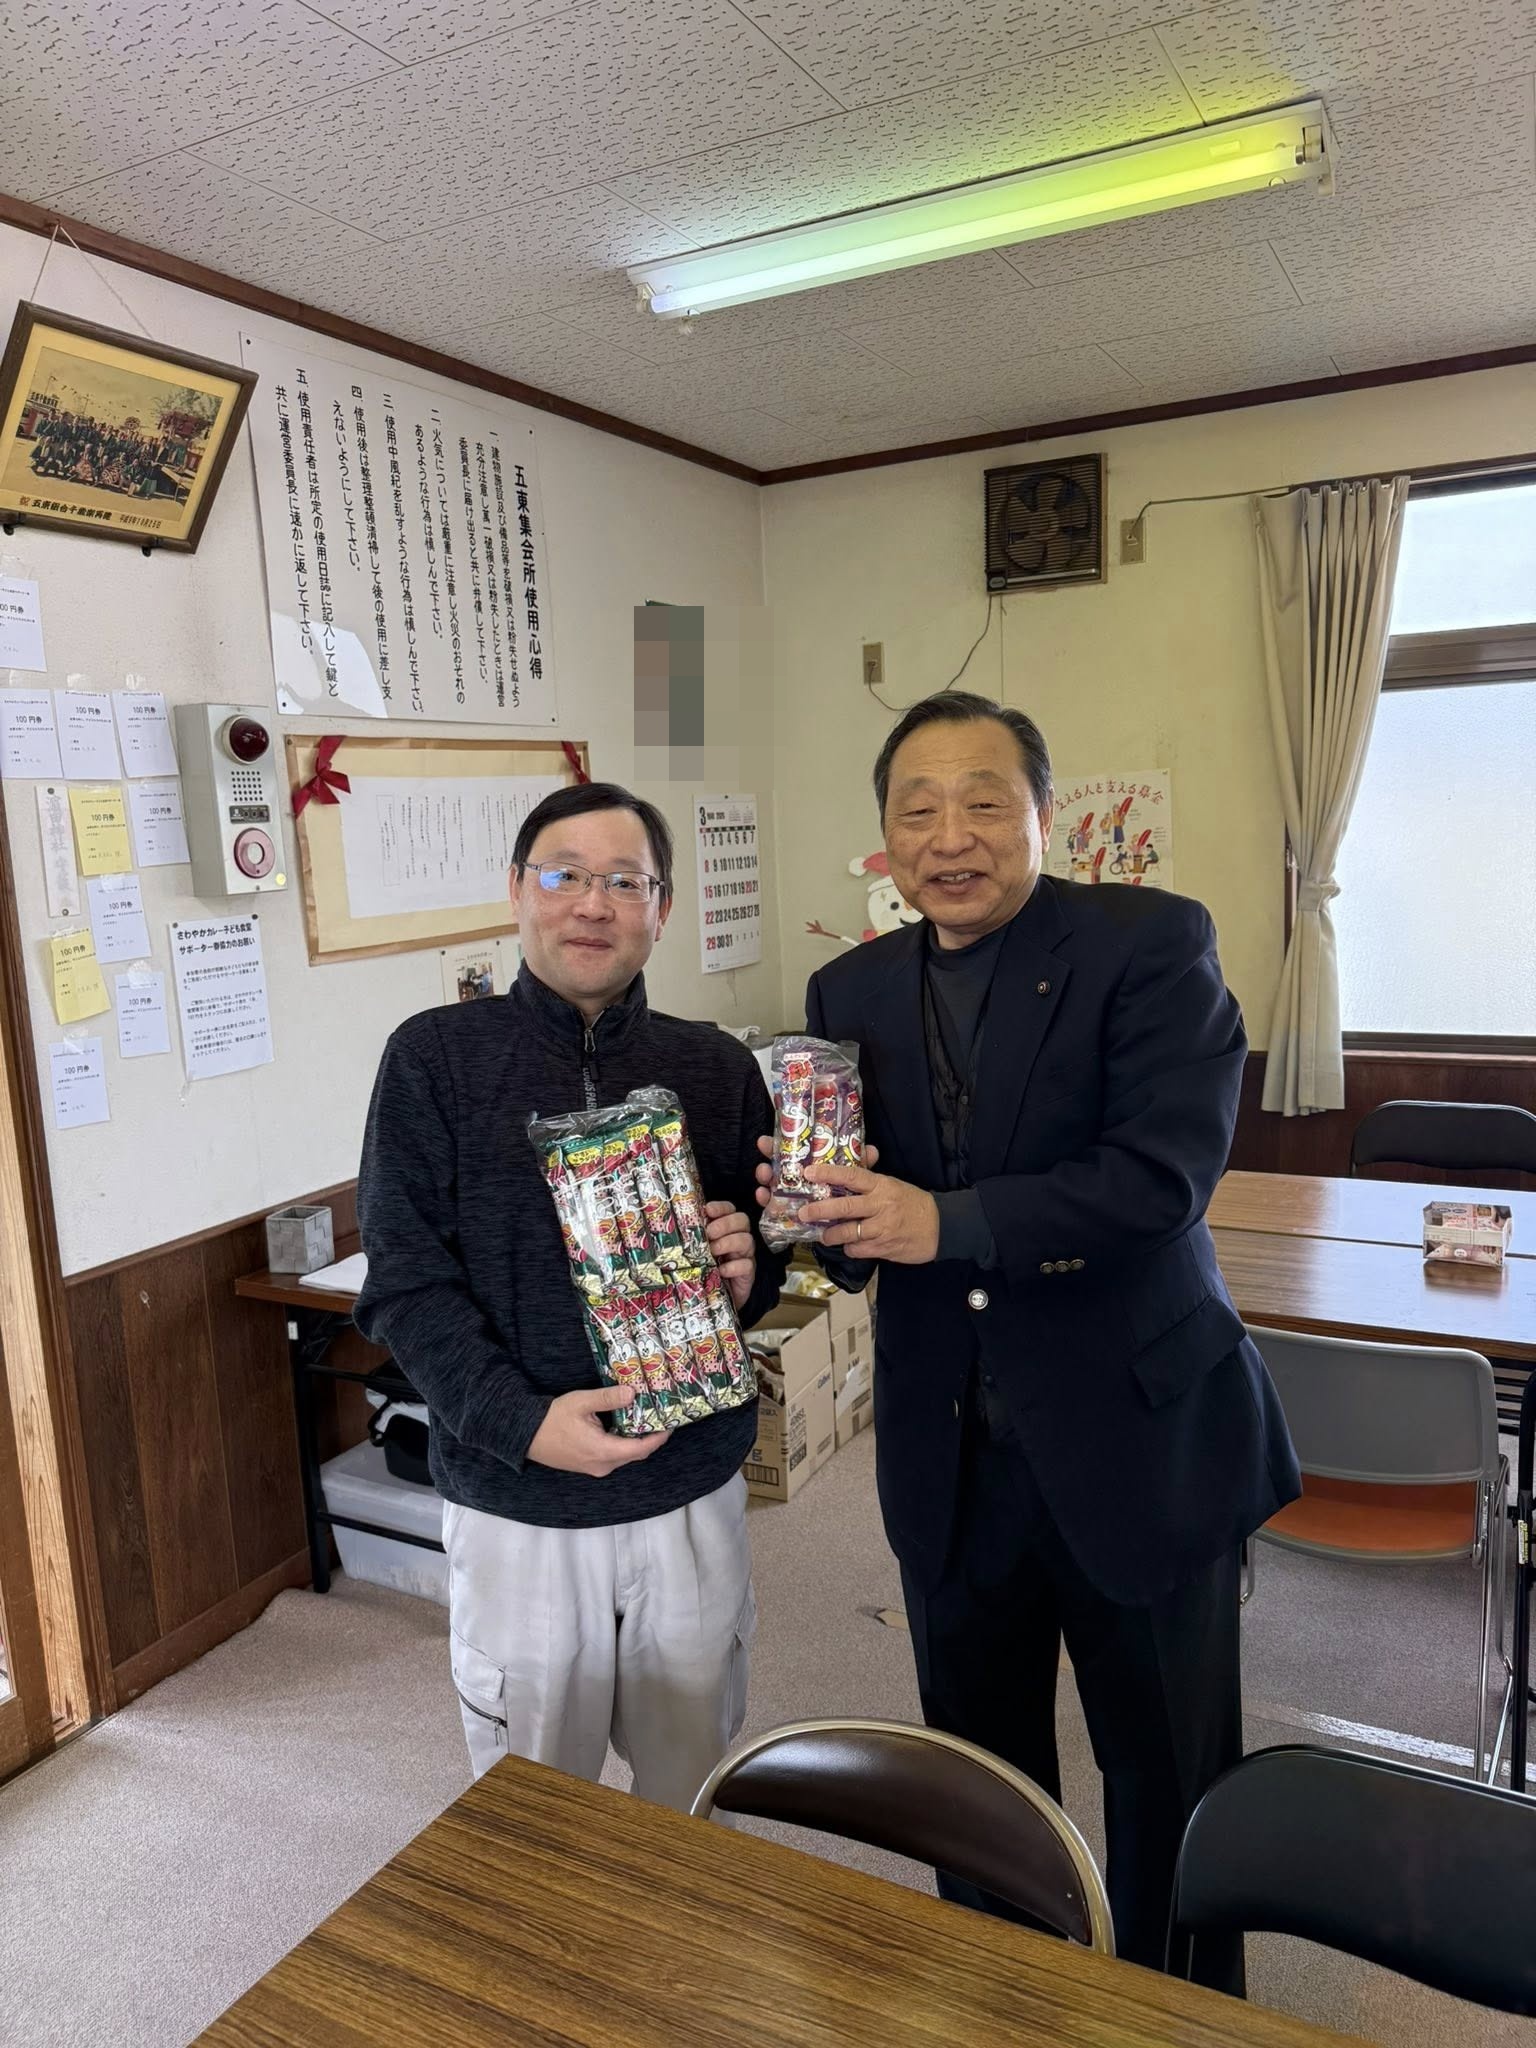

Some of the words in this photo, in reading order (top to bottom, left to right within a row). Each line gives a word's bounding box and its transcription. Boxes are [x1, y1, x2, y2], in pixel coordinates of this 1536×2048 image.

[514, 465, 544, 680] 五東集会所使用心得
[700, 806, 706, 826] 3
[703, 833, 707, 847] 1
[711, 833, 716, 847] 2
[719, 832, 724, 846] 3
[727, 832, 732, 845] 4
[735, 831, 740, 845] 5
[743, 831, 748, 844] 6
[750, 830, 755, 844] 7
[704, 859, 710, 873] 8
[713, 859, 718, 873] 9
[720, 857, 727, 871] 10
[728, 857, 735, 870] 11
[735, 856, 743, 870] 12
[743, 855, 751, 869] 13
[751, 855, 758, 868] 14
[704, 885, 713, 899] 15
[714, 884, 721, 898] 16
[722, 883, 729, 896] 17
[730, 882, 737, 896] 18
[738, 881, 745, 895] 19
[745, 880, 752, 894] 20
[752, 880, 758, 893] 21
[705, 911, 714, 925] 22
[715, 909, 723, 923] 23
[724, 908, 731, 922] 24
[732, 907, 739, 921] 25
[740, 906, 747, 920] 26
[747, 905, 753, 918] 27
[754, 903, 760, 917] 28
[177, 922, 252, 940] さわやかカレー子ども食堂
[706, 936, 716, 950] 29
[716, 934, 725, 949] 30
[725, 934, 733, 948] 31
